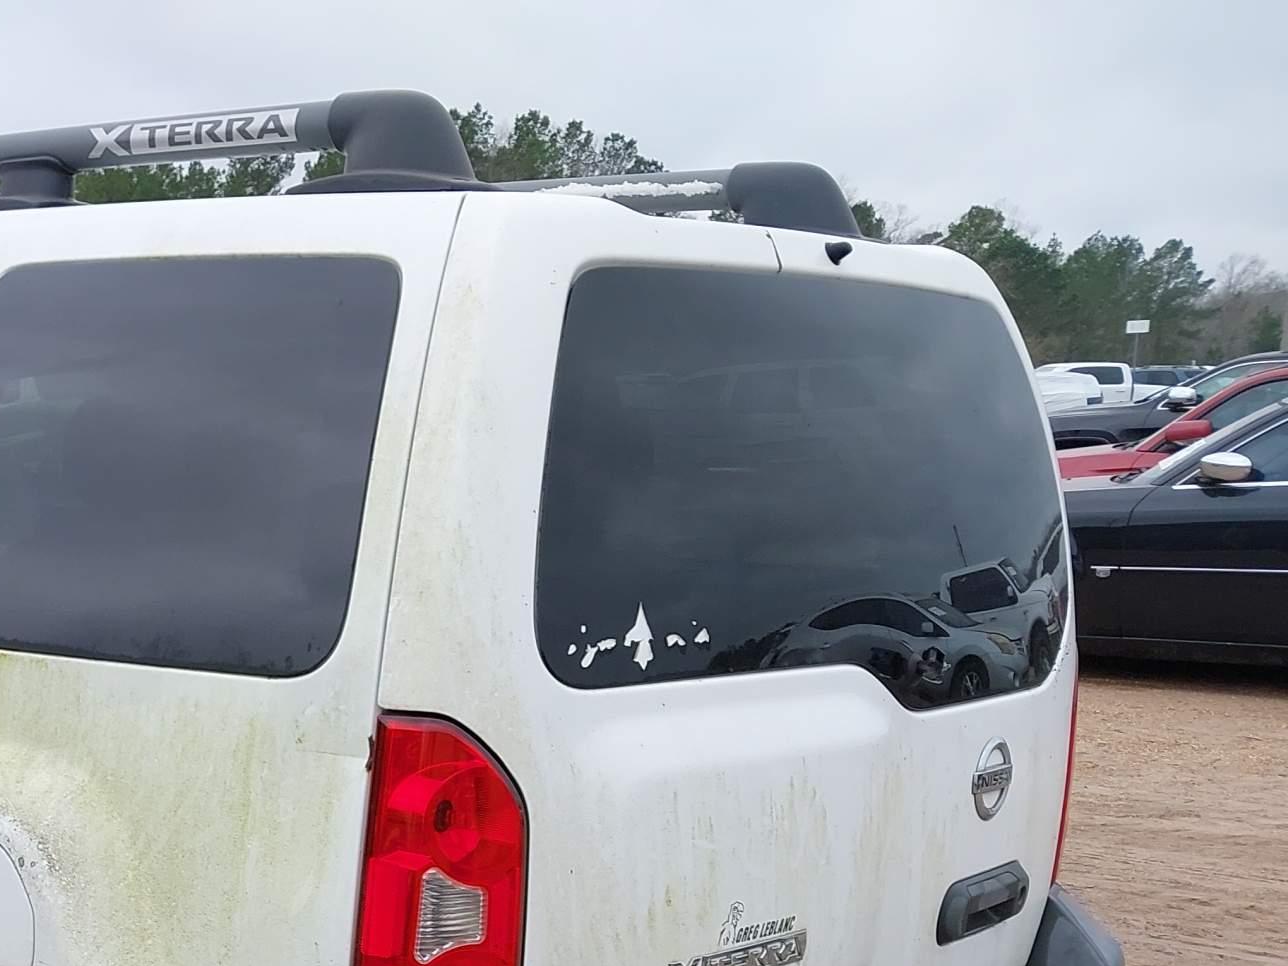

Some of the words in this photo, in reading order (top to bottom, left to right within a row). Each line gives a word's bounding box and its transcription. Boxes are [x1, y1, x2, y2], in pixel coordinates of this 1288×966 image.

[88, 113, 290, 159] XTERRA
[736, 924, 760, 944] GREG
[760, 915, 796, 938] LEBLANC
